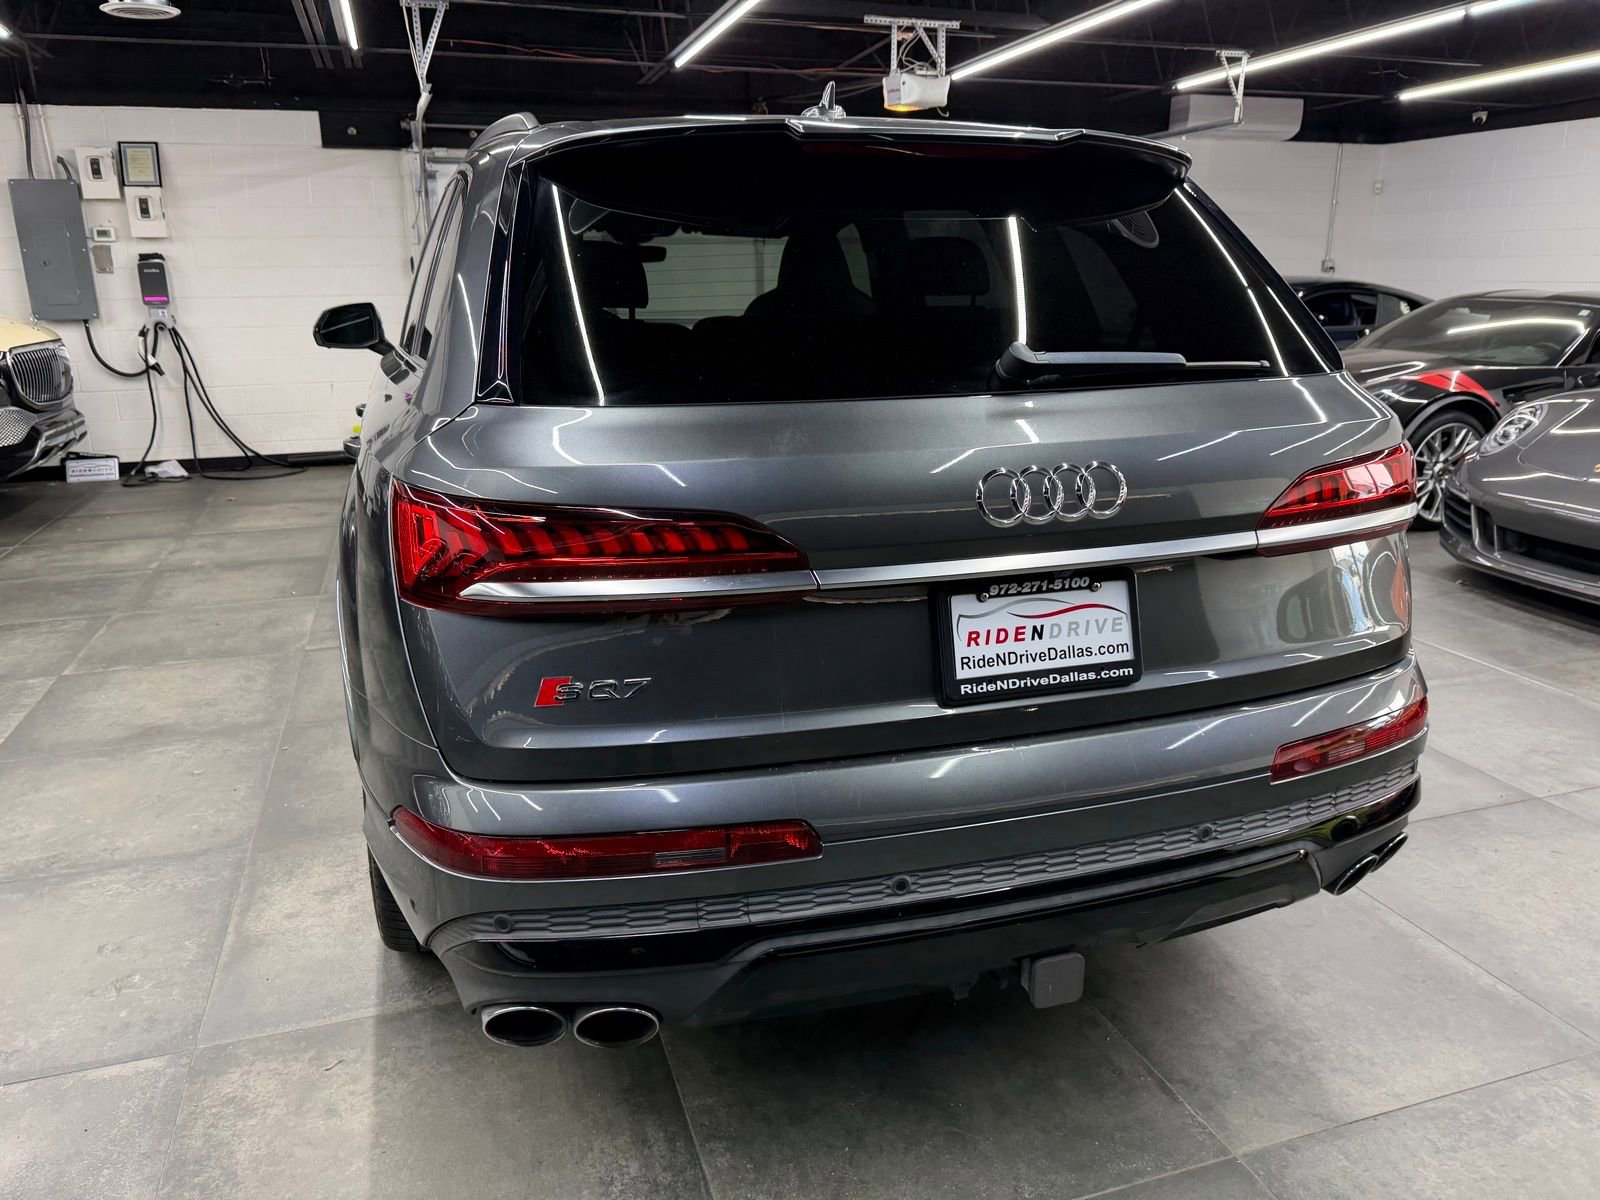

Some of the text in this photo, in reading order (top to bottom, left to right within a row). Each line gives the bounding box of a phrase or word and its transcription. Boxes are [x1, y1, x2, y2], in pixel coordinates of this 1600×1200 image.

[989, 576, 1090, 596] 972-271-5100
[960, 642, 1130, 671] RideNDriveDallas.com
[553, 677, 652, 701] SQ7
[960, 667, 1134, 695] RideNDriveDallas.com
